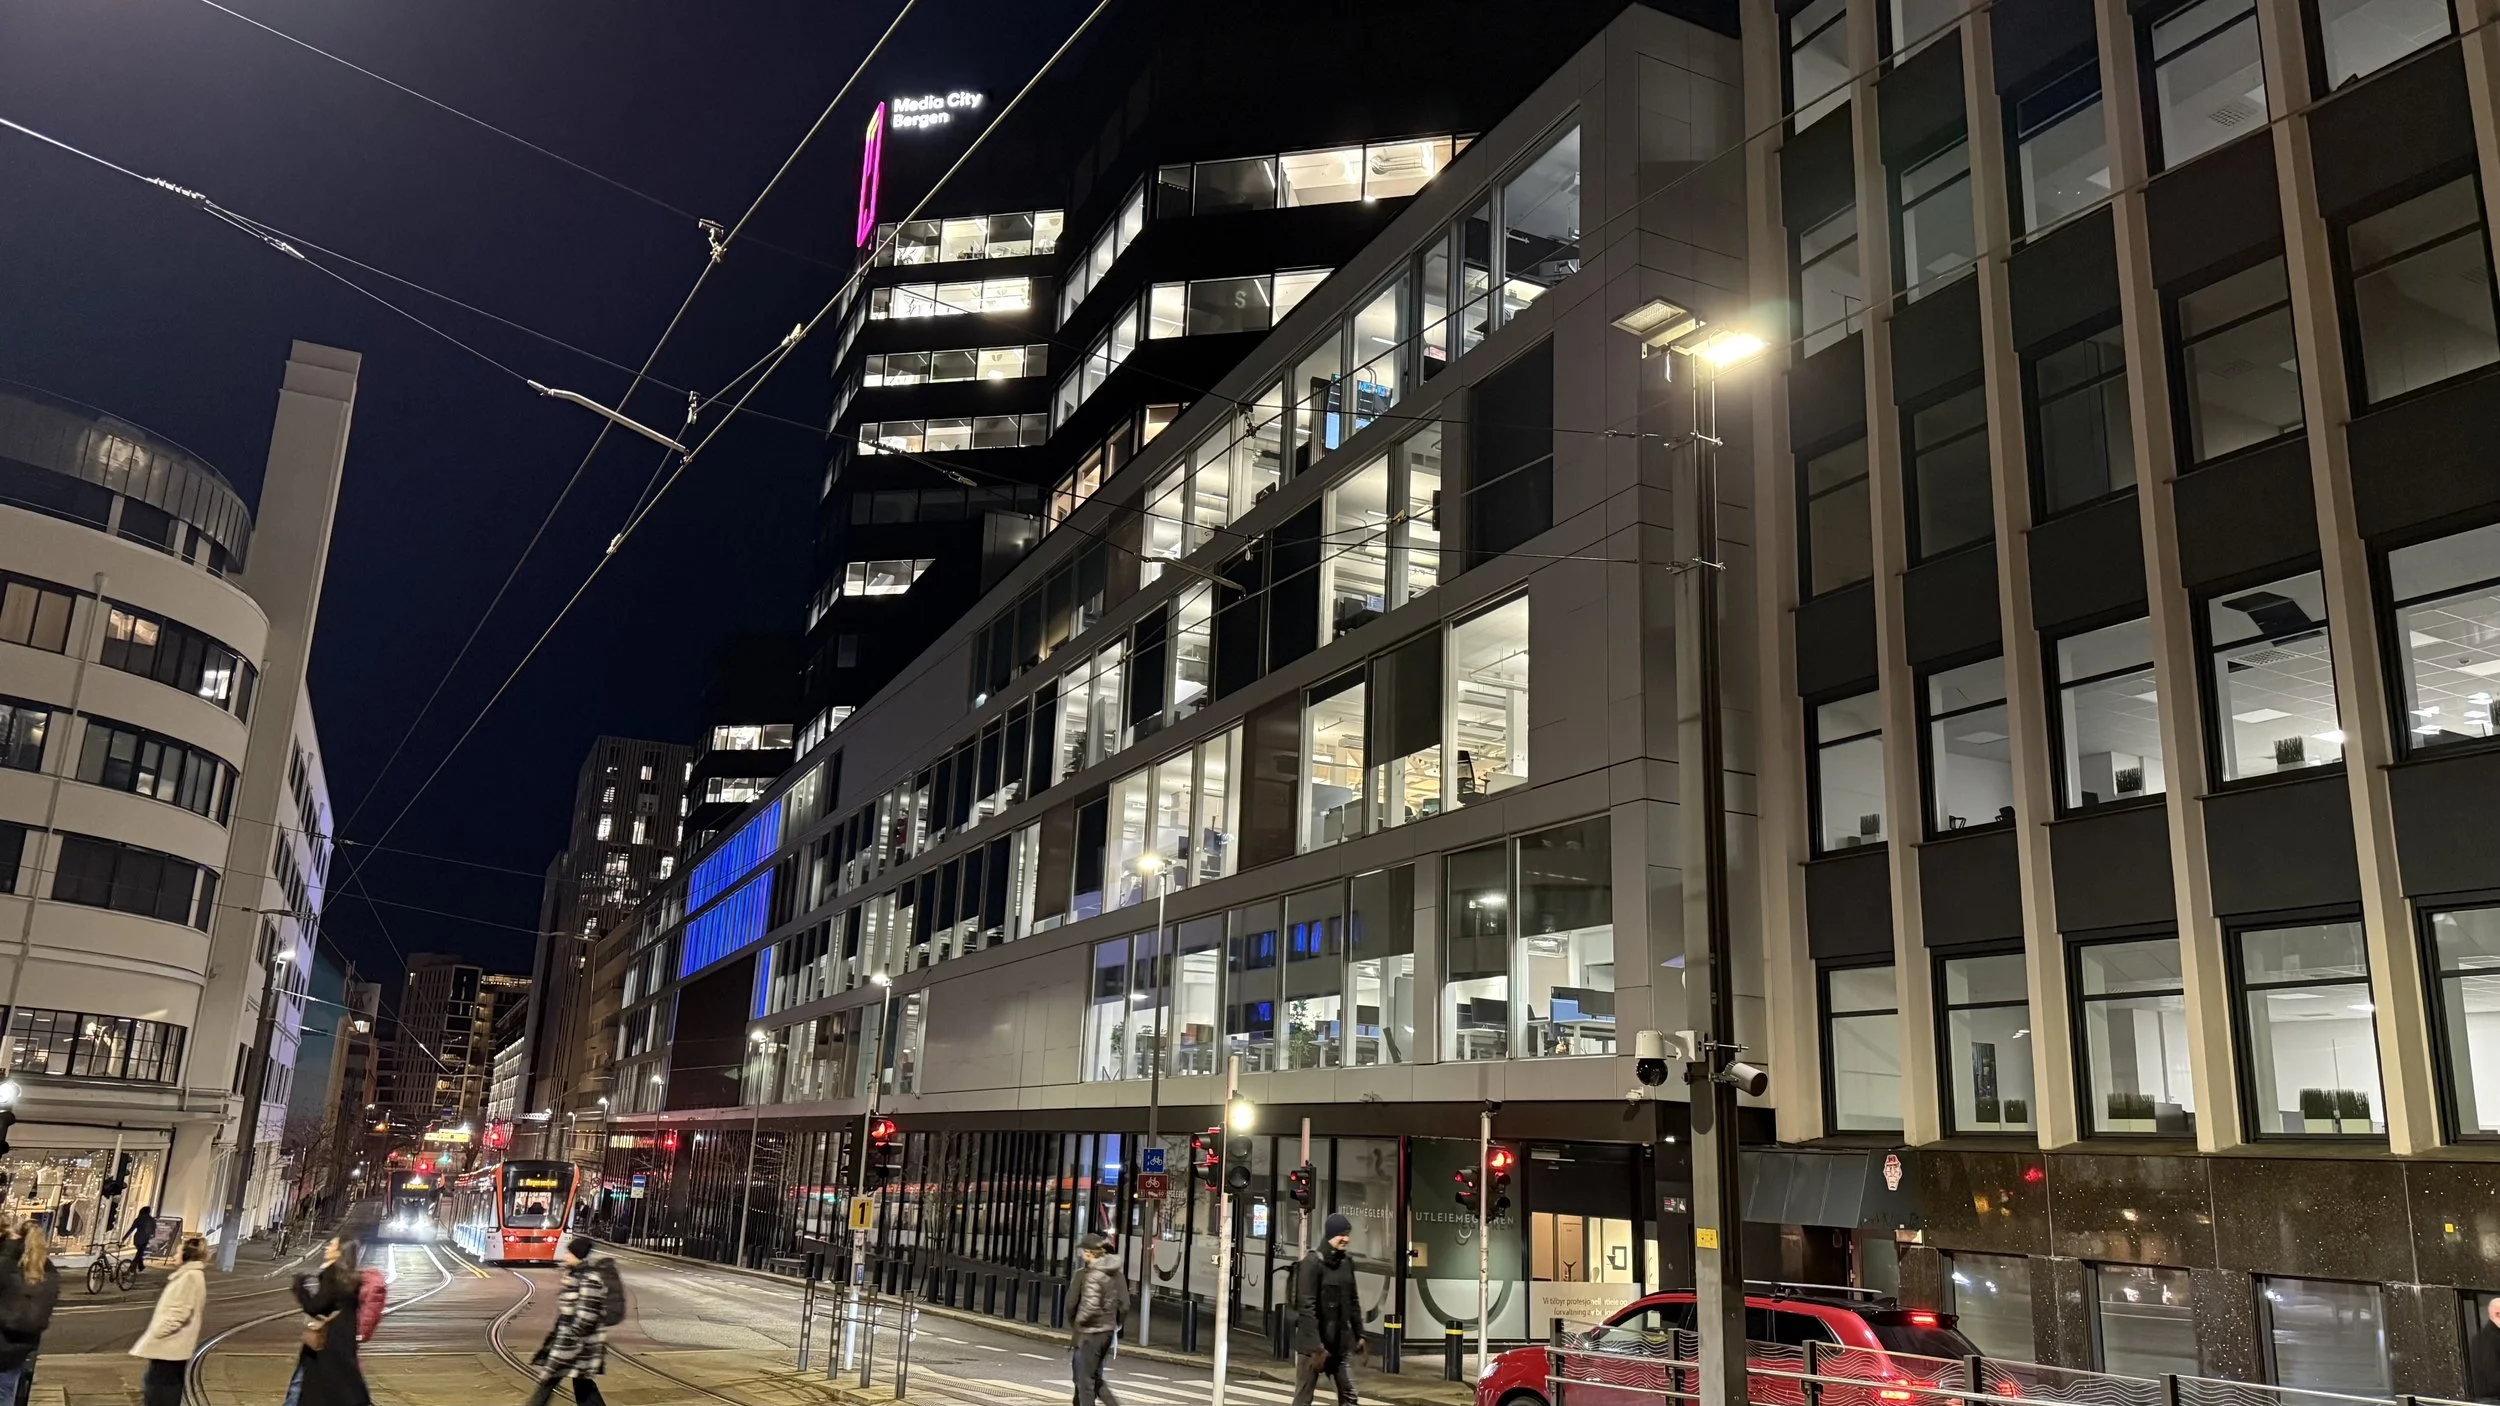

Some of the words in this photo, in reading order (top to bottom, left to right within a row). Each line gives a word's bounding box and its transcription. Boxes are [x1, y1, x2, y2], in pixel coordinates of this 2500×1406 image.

[893, 95, 944, 113] Media
[947, 91, 983, 108] City
[893, 112, 950, 129] Bergen
[1415, 1211, 1514, 1225] UTLEIEMEGREN
